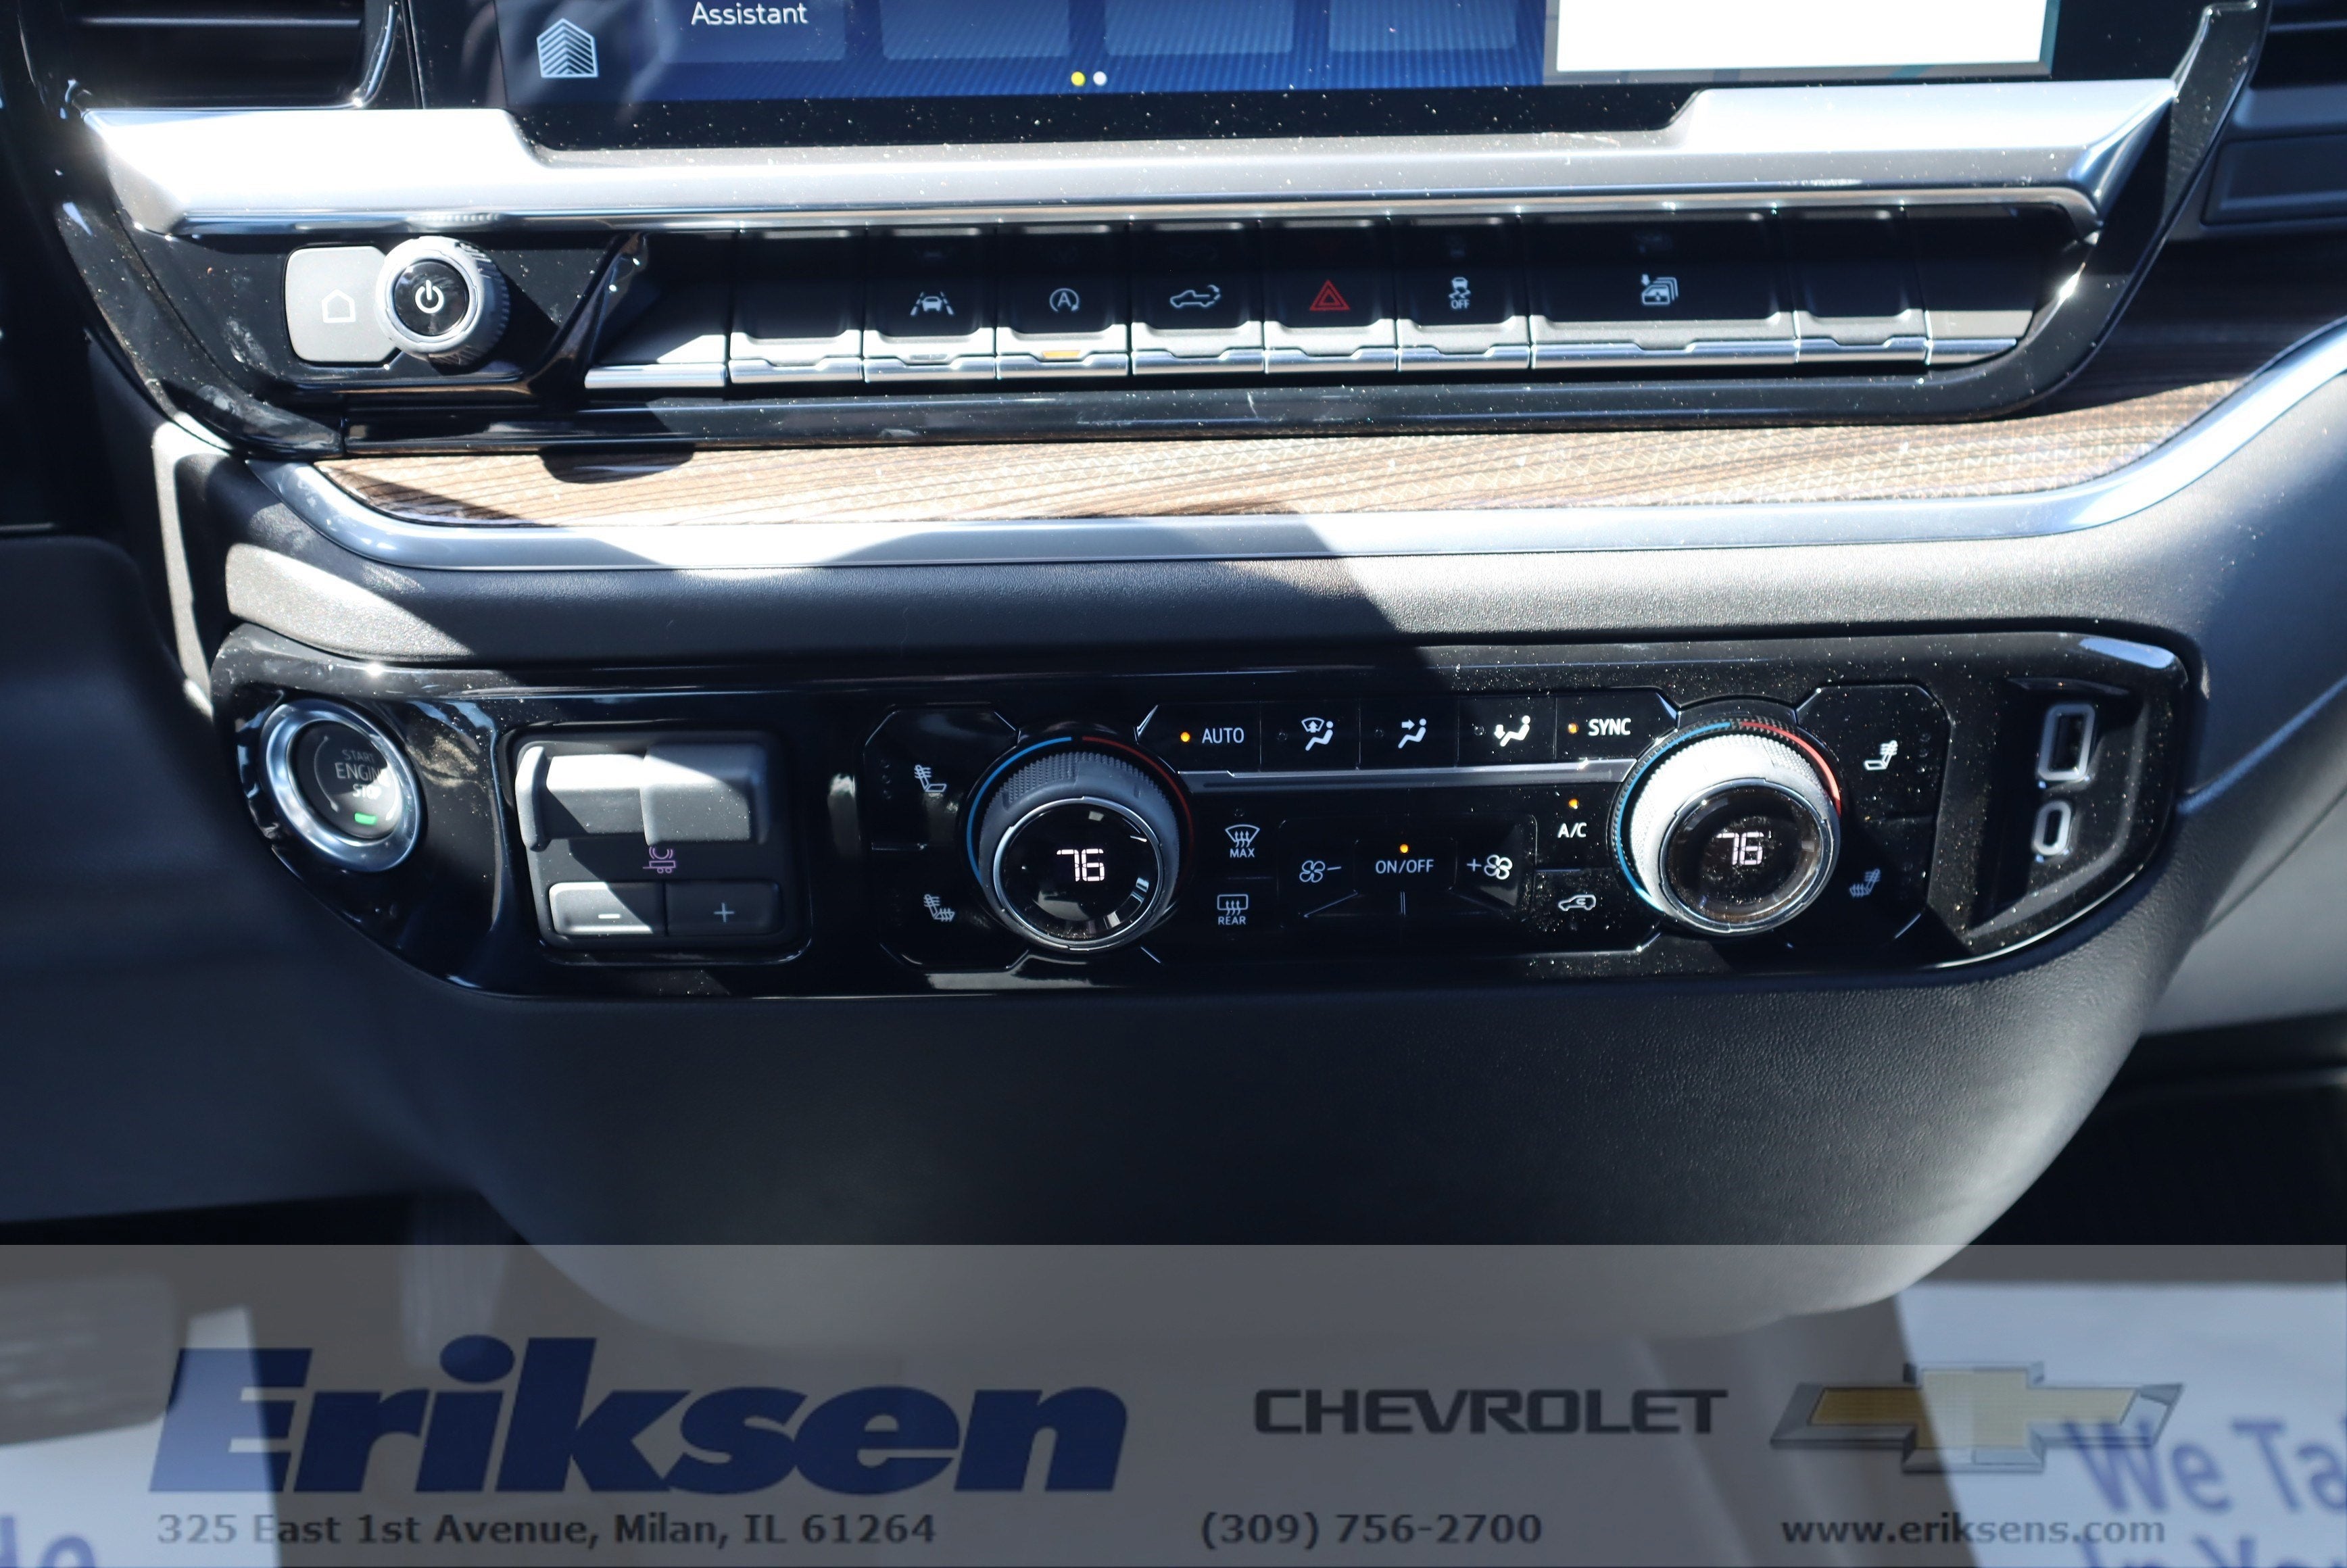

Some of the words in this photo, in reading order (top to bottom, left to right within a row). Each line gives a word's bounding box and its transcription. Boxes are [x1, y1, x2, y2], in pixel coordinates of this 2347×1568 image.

[691, 1, 808, 25] Assistant
[1450, 298, 1470, 310] OFF
[1201, 727, 1244, 744] AUTO
[1588, 717, 1632, 737] SYNC
[341, 749, 374, 763] START
[1557, 822, 1587, 839] A/C
[1229, 848, 1255, 858] MAX
[1716, 831, 1764, 866] 76
[1056, 848, 1105, 882] 76
[1375, 858, 1434, 874] ON/OFF
[1217, 915, 1247, 926] REAR
[2063, 1417, 2233, 1514] We
[2229, 1411, 2347, 1514] Ta
